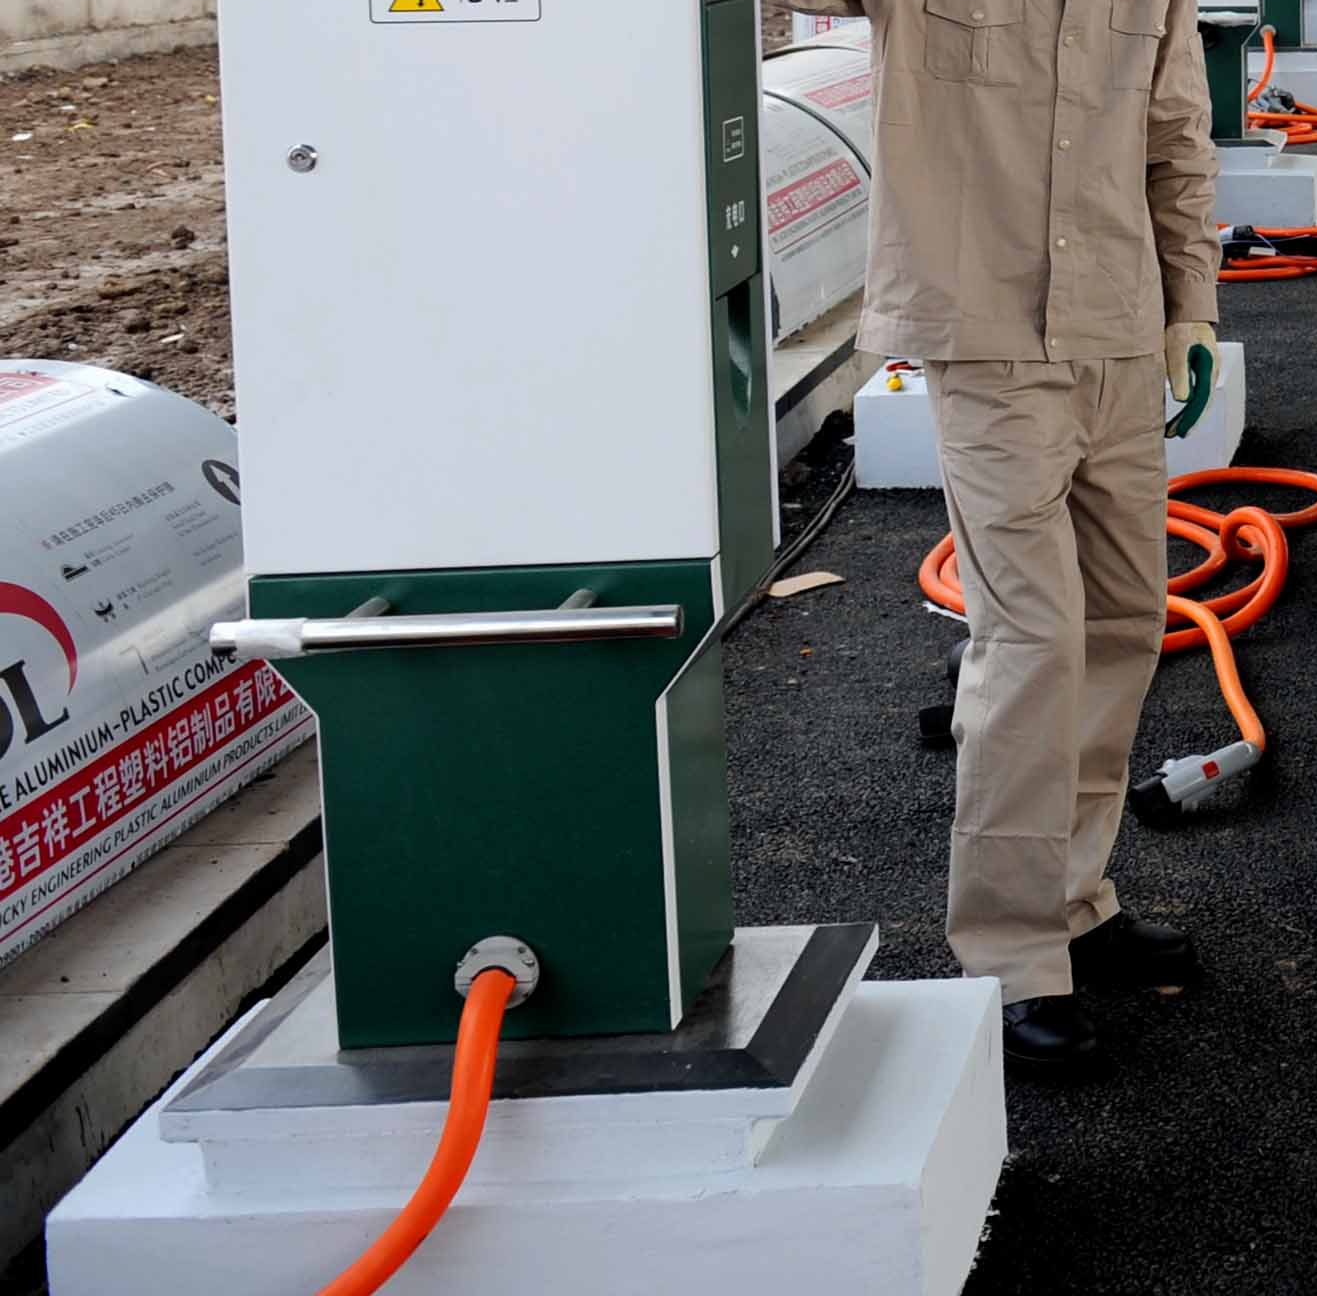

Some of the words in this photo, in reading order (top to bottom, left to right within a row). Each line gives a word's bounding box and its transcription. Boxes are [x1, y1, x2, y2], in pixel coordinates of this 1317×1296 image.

[0, 659, 71, 760] L
[14, 676, 185, 802] ALUMINIUM-PLASTIC
[0, 897, 31, 928] CKY
[31, 837, 113, 906] ENGINEERING
[113, 803, 159, 848] PLASTIC
[159, 755, 223, 812] ALUMINIUM
[222, 722, 274, 770] PRODUCTS
